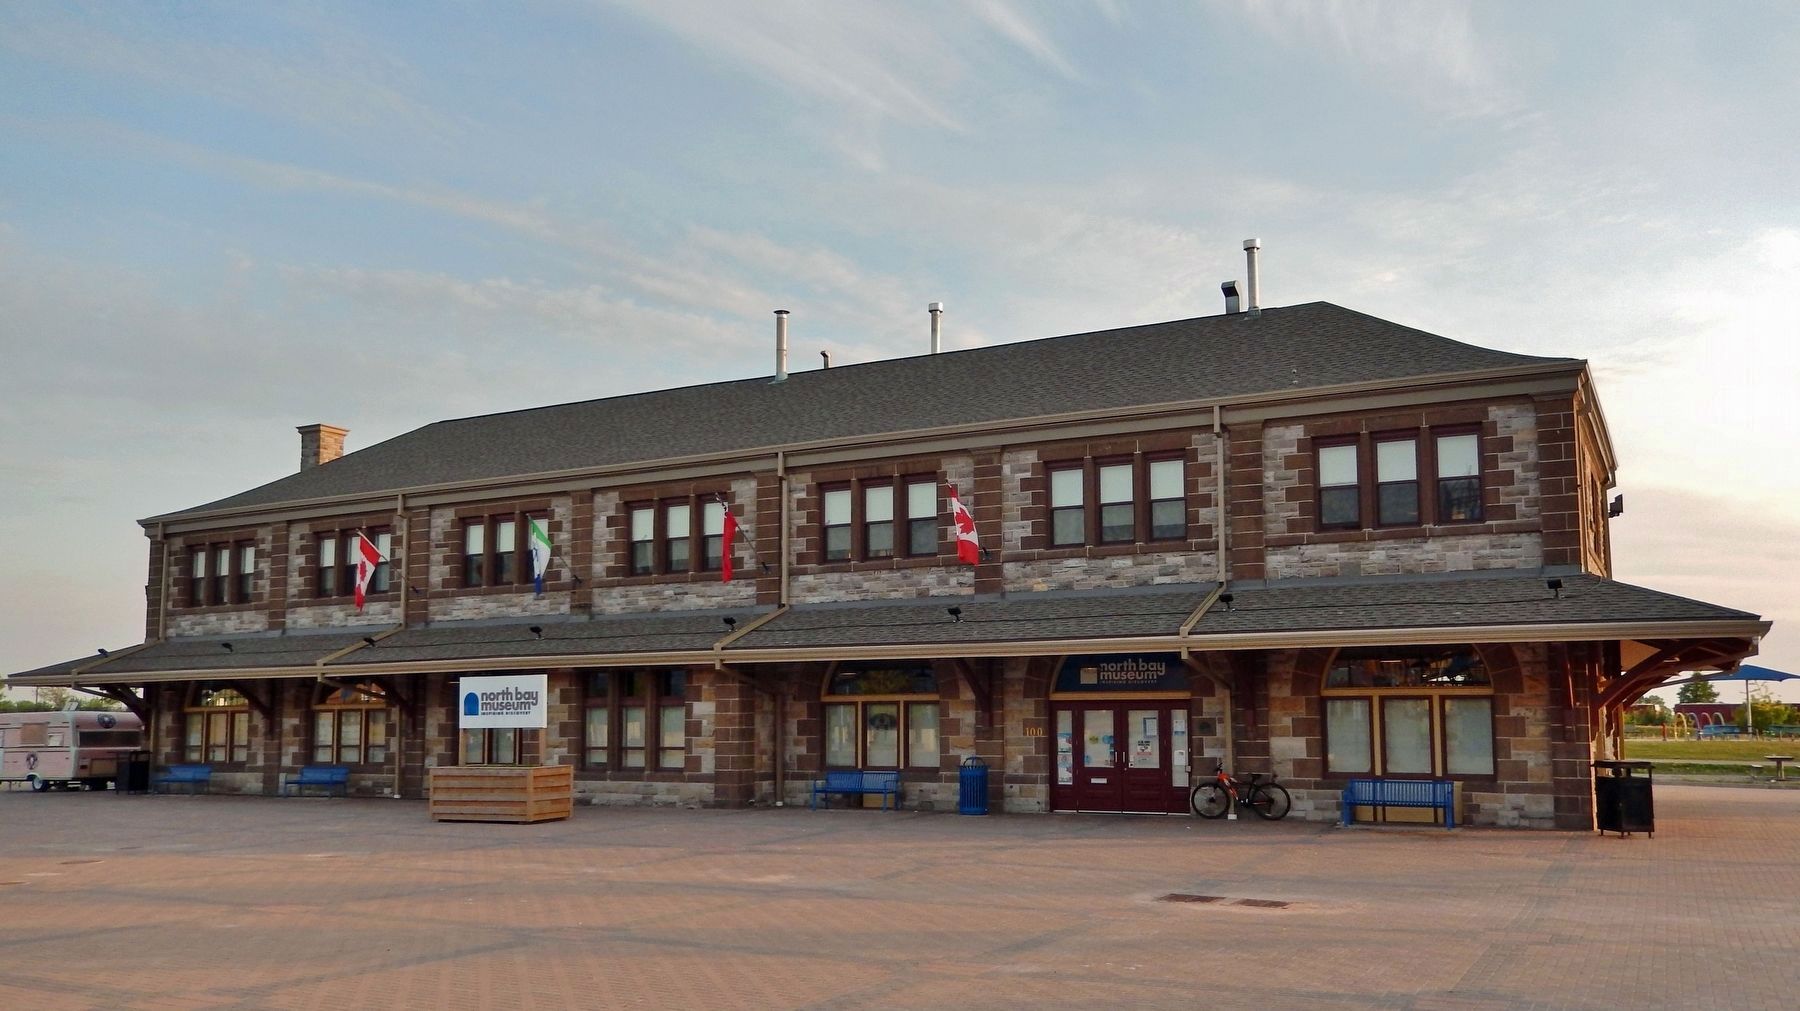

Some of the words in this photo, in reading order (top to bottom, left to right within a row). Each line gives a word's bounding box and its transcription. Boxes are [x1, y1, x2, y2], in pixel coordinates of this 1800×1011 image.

[1100, 658, 1136, 671] north
[1139, 658, 1166, 675] bay
[1100, 670, 1157, 680] museum
[481, 687, 513, 701] north
[515, 686, 539, 706] bay
[481, 701, 531, 711] museum
[1025, 727, 1043, 737] 100
